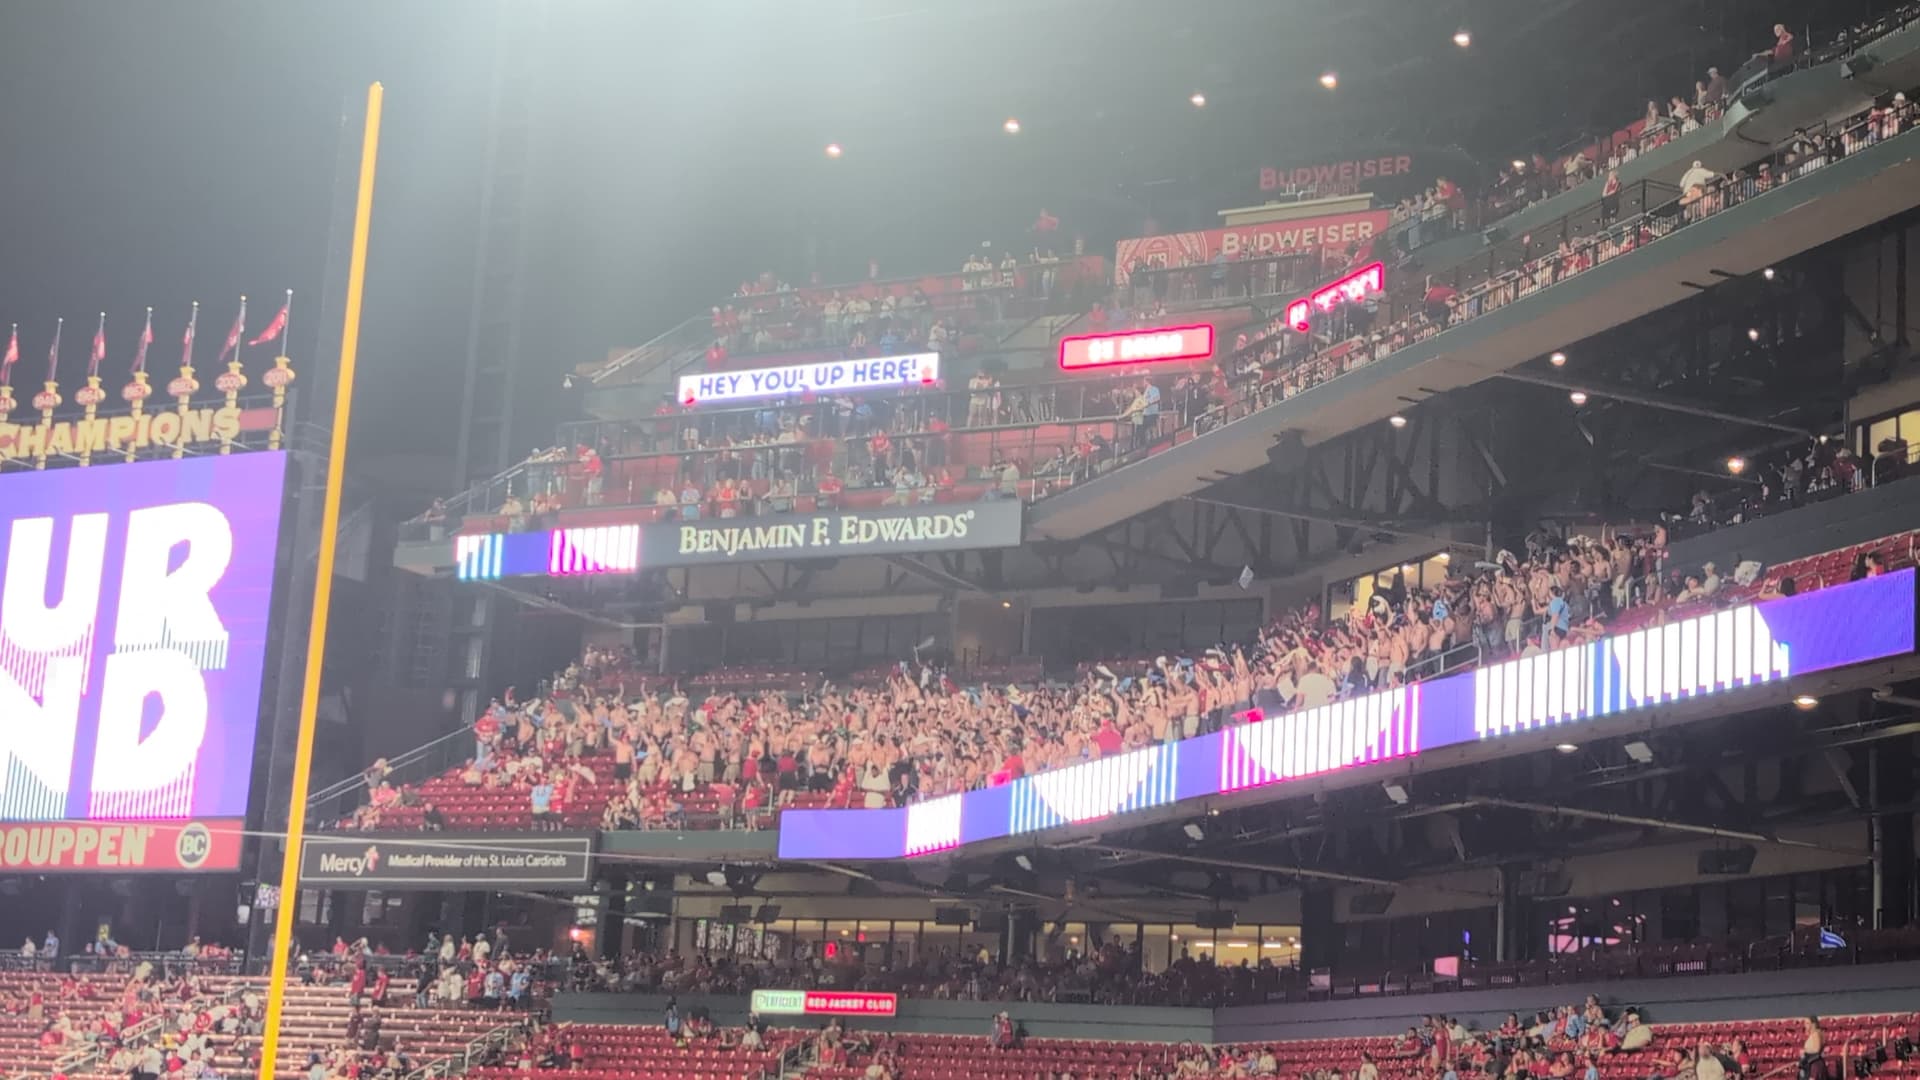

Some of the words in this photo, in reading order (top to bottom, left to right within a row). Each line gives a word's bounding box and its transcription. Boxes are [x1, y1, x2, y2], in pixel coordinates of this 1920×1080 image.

[1260, 156, 1412, 190] BUDWEISER
[1222, 221, 1374, 256] BUDWEISER
[699, 375, 742, 397] HEY
[750, 369, 805, 392] YOU!
[813, 365, 844, 387] UP
[852, 358, 918, 384] HERE!
[0, 408, 241, 460] CHAMPIONS
[678, 524, 806, 556] BENJAMIN
[811, 518, 831, 545] F.
[181, 834, 206, 855] BC
[388, 855, 425, 867] Medical
[425, 855, 463, 868] Provider
[463, 855, 474, 867] of
[474, 855, 489, 867] the
[489, 855, 500, 867] St.
[501, 855, 524, 867] Louis
[525, 855, 567, 867] Cardinals
[320, 853, 368, 876] Mercy
[806, 997, 827, 1009] RED
[866, 999, 893, 1011] CLUB
